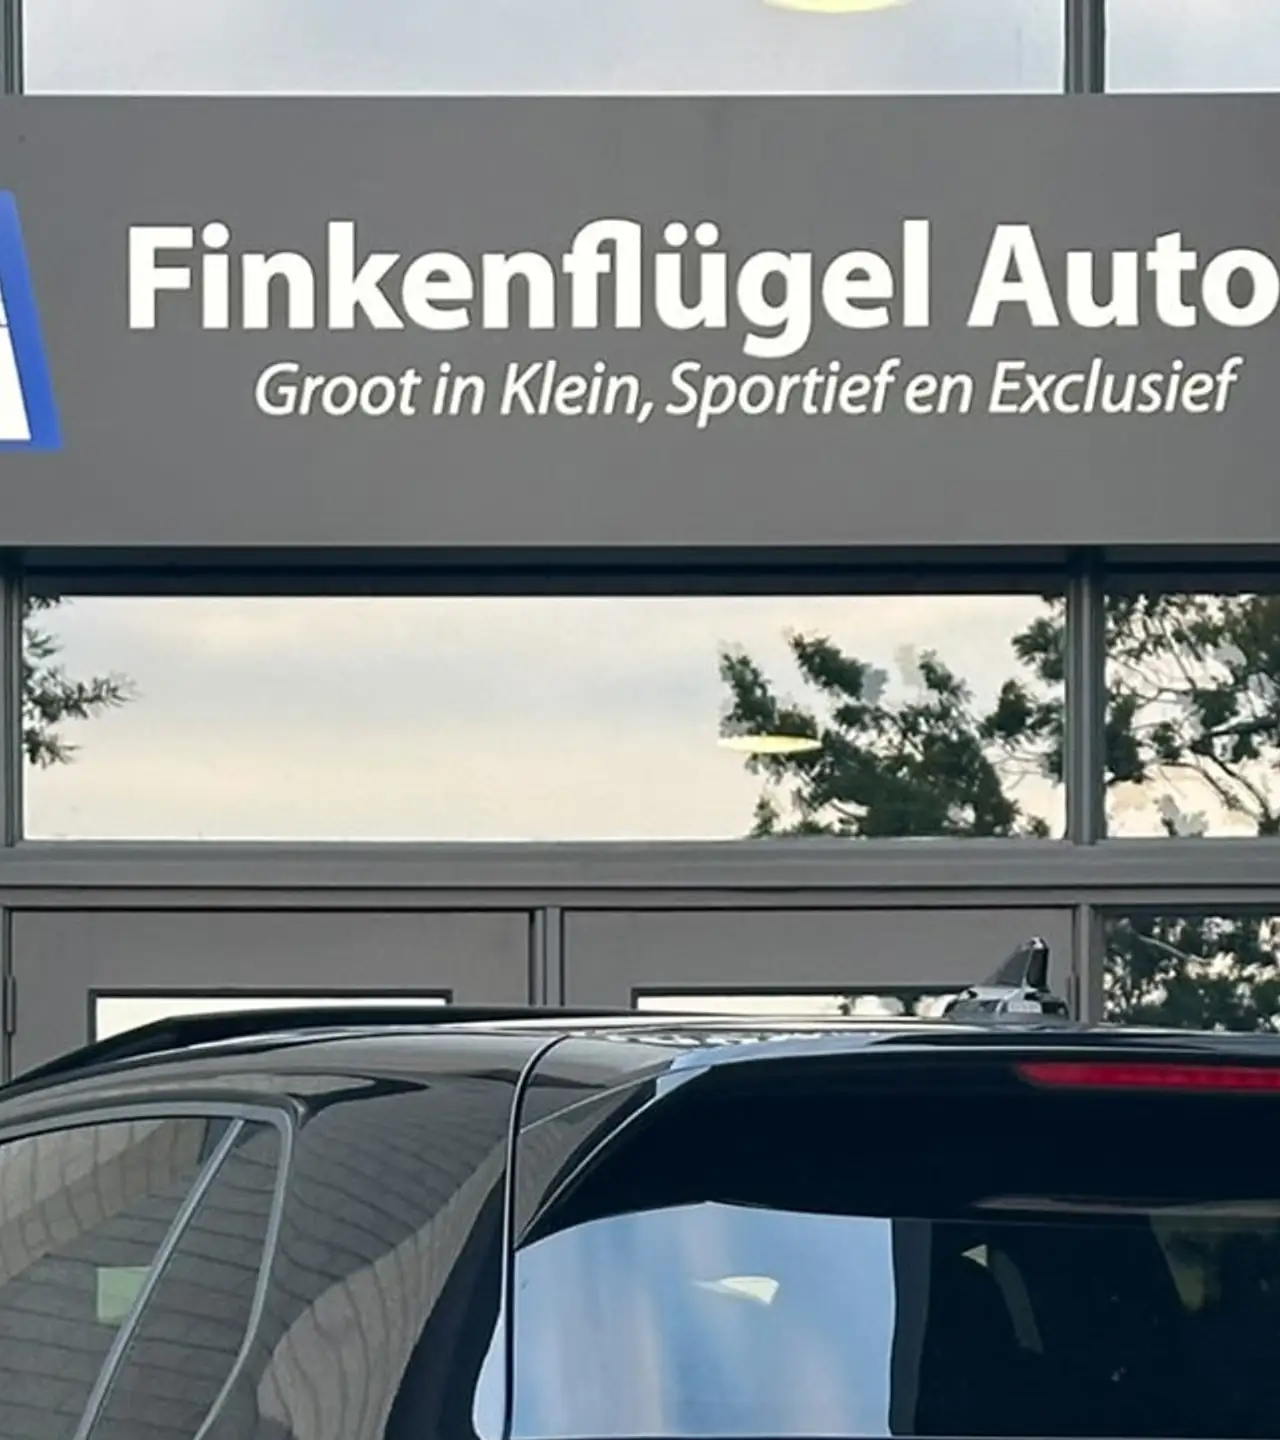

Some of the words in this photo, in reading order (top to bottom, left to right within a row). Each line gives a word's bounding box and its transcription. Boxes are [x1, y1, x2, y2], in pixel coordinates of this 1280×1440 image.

[129, 219, 929, 359] Finkenflügel
[255, 362, 424, 416] Groot
[432, 361, 486, 416] in
[500, 359, 655, 424] Klein,
[665, 358, 902, 429] Sportief
[904, 374, 973, 415] en
[988, 356, 1245, 414] Exclusief
